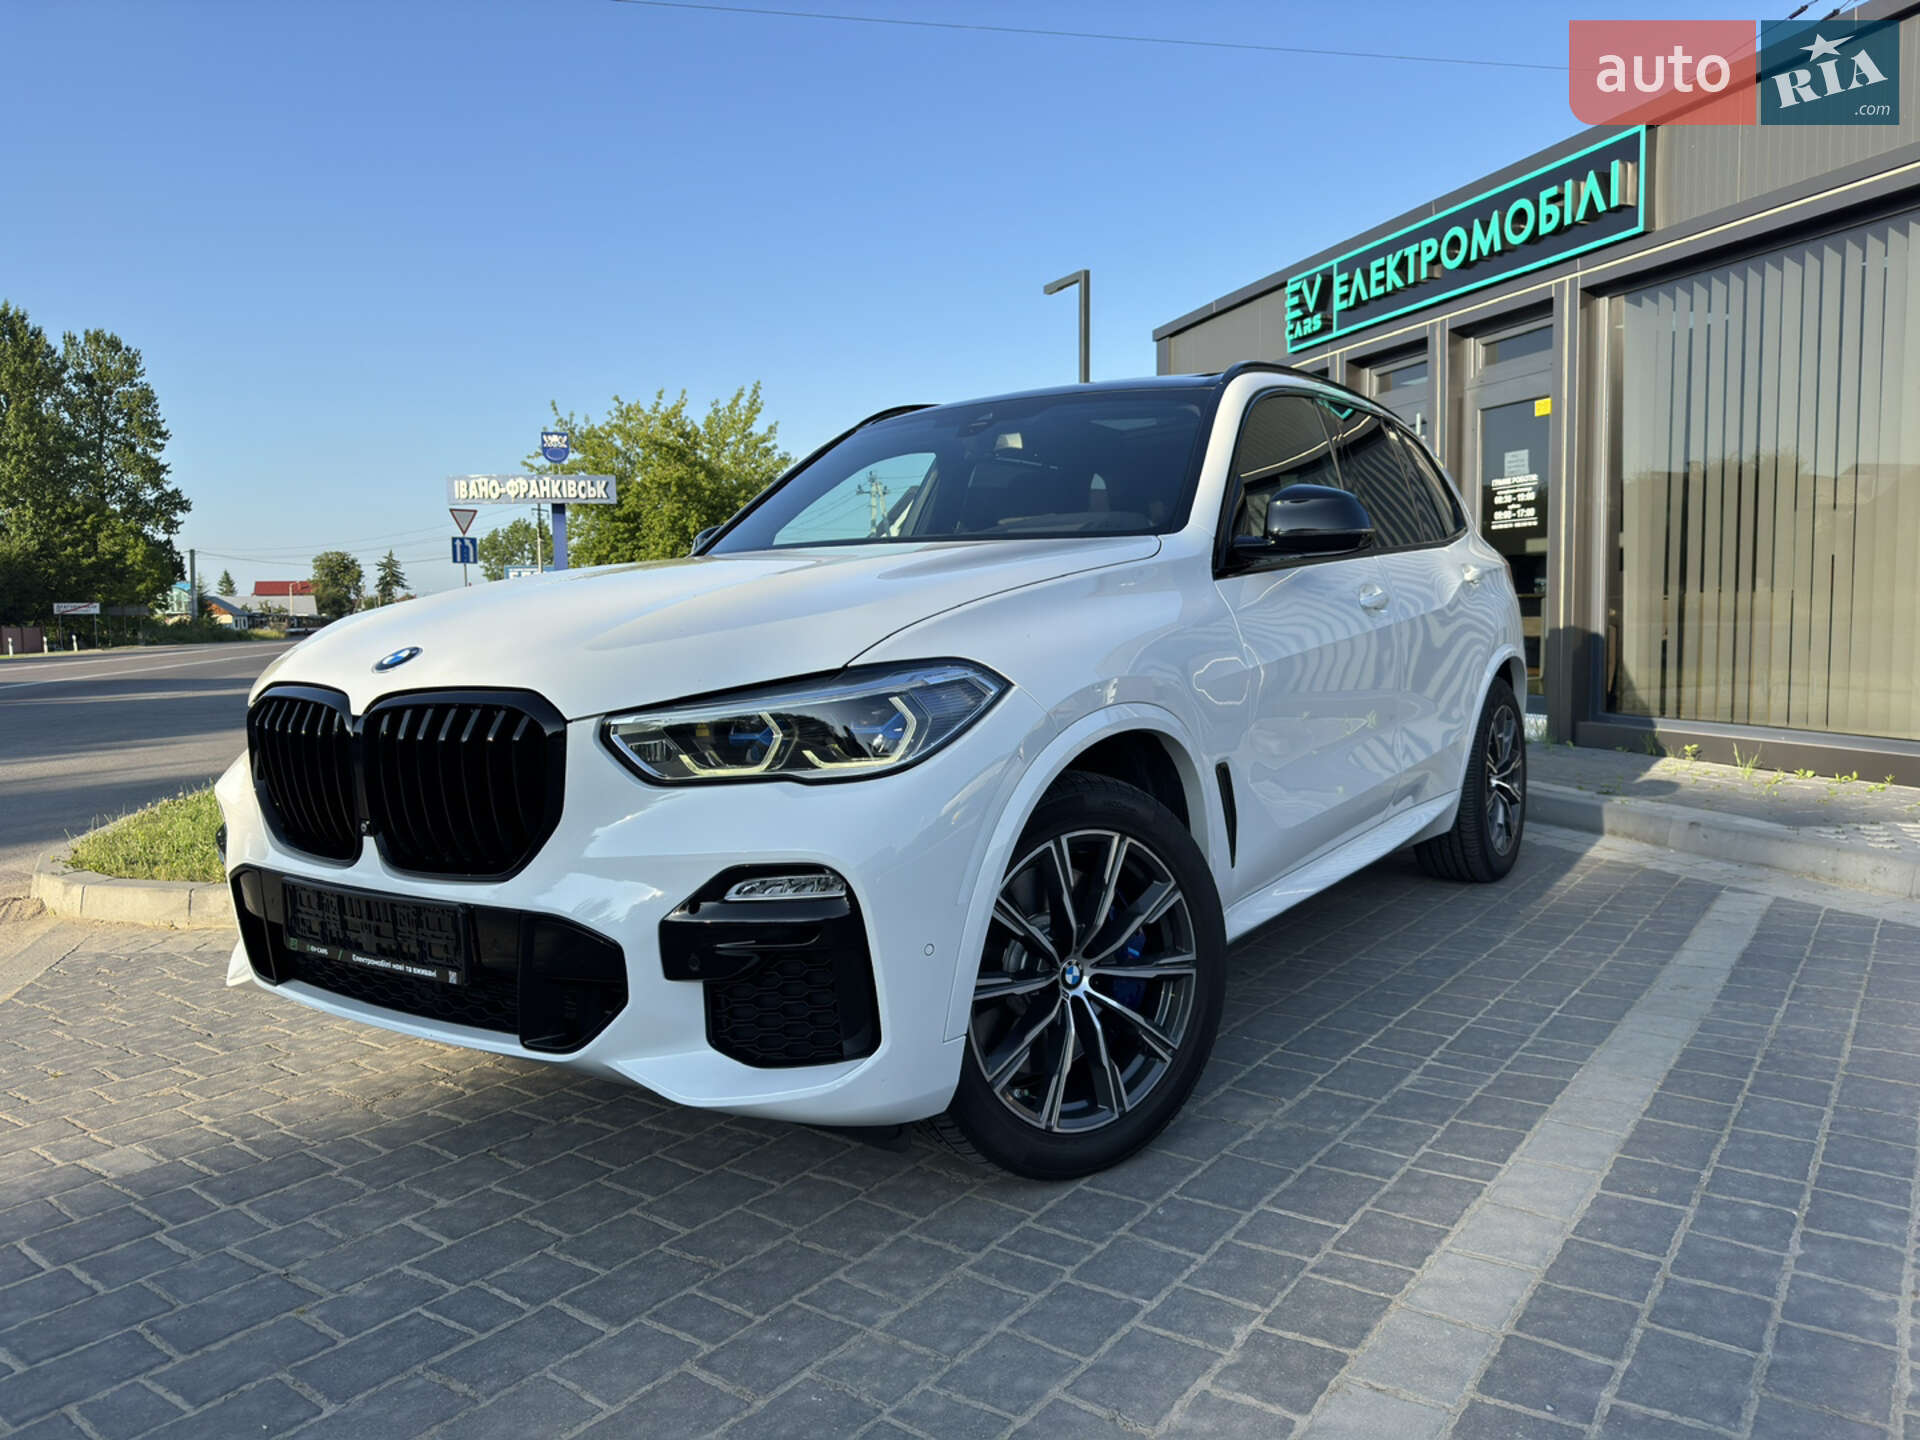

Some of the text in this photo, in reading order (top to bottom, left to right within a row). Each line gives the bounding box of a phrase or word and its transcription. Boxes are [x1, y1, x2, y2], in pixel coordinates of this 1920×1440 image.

[1335, 160, 1620, 312] ЕЛЕКТРОМОБІЛІ
[1285, 273, 1322, 321] EV
[1285, 313, 1322, 341] CARS
[454, 477, 608, 501] ІВАНО-ФРАНКІВСЬК
